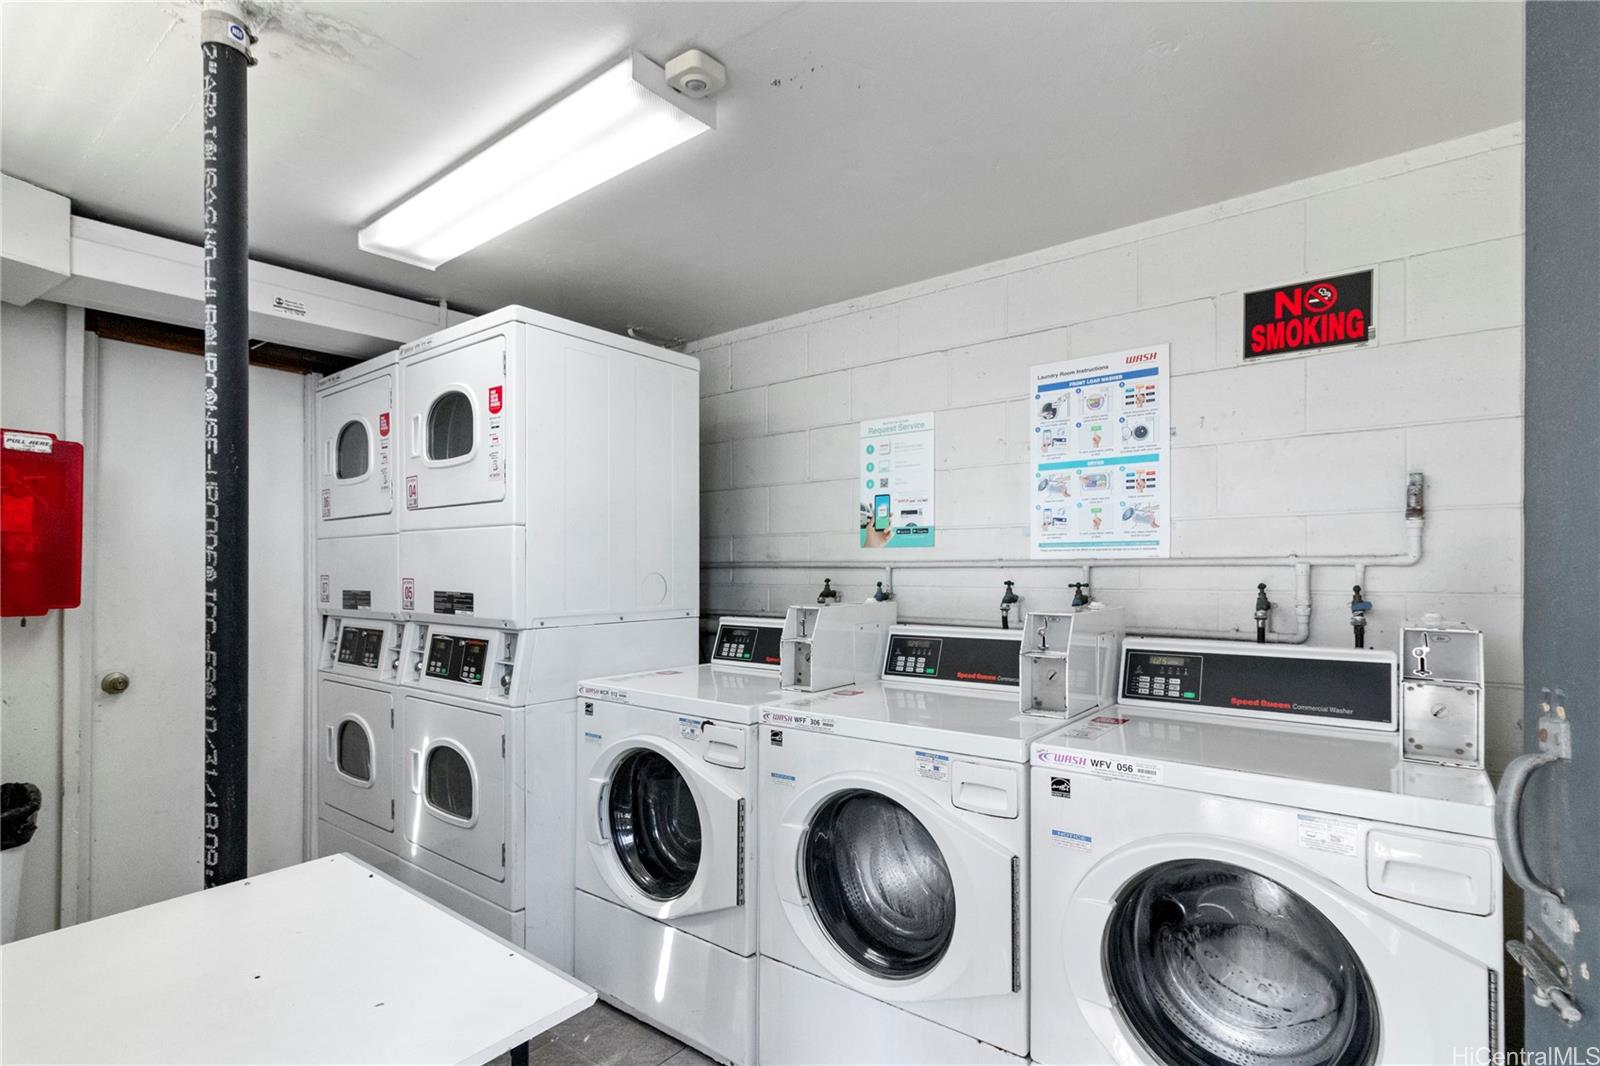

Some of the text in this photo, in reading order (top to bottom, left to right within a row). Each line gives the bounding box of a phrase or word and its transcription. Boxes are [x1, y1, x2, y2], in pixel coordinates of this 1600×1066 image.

[1251, 309, 1364, 353] SMOKING
[1125, 352, 1157, 364] WASH
[1037, 372, 1058, 380] Laundry
[1076, 365, 1109, 374] Instructions
[868, 425, 896, 436] Request
[897, 422, 925, 432] Service
[404, 586, 413, 600] 05
[957, 671, 977, 680] Speed
[1231, 697, 1354, 715] Speed Queen Commercial Washer
[772, 713, 821, 727] WASH WFF 306
[1053, 753, 1134, 773] WASH WFV 056
